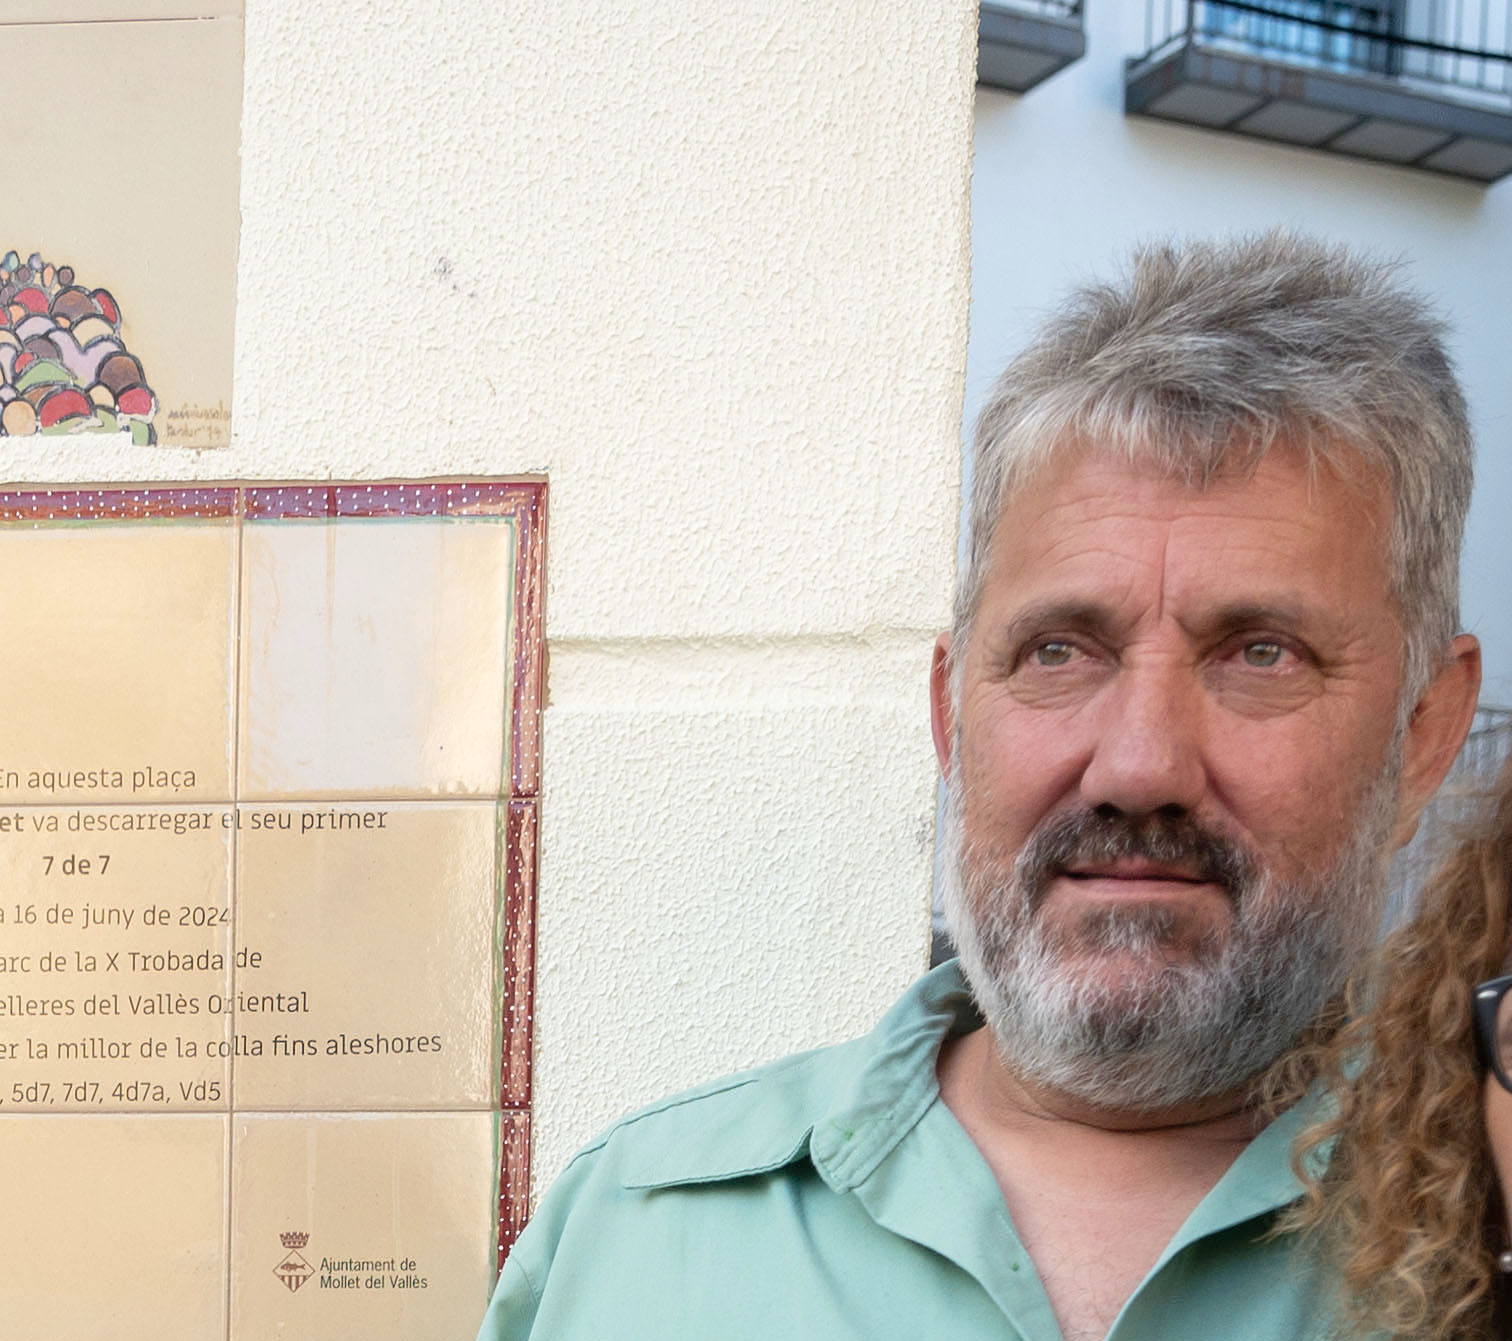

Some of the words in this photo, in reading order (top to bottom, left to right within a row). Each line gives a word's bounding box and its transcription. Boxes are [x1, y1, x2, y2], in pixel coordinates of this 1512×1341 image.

[28, 767, 124, 793] aquesta
[132, 766, 197, 793] plaça
[33, 814, 59, 832] va
[67, 810, 213, 835] descarregar
[221, 808, 243, 831] el
[251, 811, 292, 830] seu
[301, 808, 389, 834] primer
[42, 855, 55, 876] 7
[62, 854, 91, 875] de
[99, 855, 111, 875] 7
[13, 904, 37, 924] 16
[46, 903, 74, 924] de
[81, 902, 135, 930] juny
[143, 904, 171, 926] de
[178, 905, 232, 927] 2024
[39, 951, 67, 972] de
[75, 951, 97, 972] la
[106, 952, 120, 972] X
[128, 949, 224, 972] Trobada
[236, 946, 262, 968] de
[83, 994, 121, 1016] del
[128, 992, 200, 1015] Vallès
[26, 1037, 49, 1060] la
[57, 1037, 132, 1060] millor
[139, 1036, 168, 1058] de
[176, 1036, 198, 1058] la
[206, 1034, 263, 1058] colla
[272, 1033, 318, 1056] fins
[325, 1033, 443, 1056] aleshores
[10, 1081, 55, 1105] 5d7,
[62, 1081, 104, 1105] 7d7,
[111, 1080, 171, 1104] 4d7a,
[179, 1080, 221, 1103] Vd5
[319, 1257, 396, 1274] Ajuntament
[399, 1257, 417, 1272] de
[319, 1275, 360, 1289] Mollet
[365, 1275, 385, 1289] del
[389, 1275, 429, 1289] Vallès
